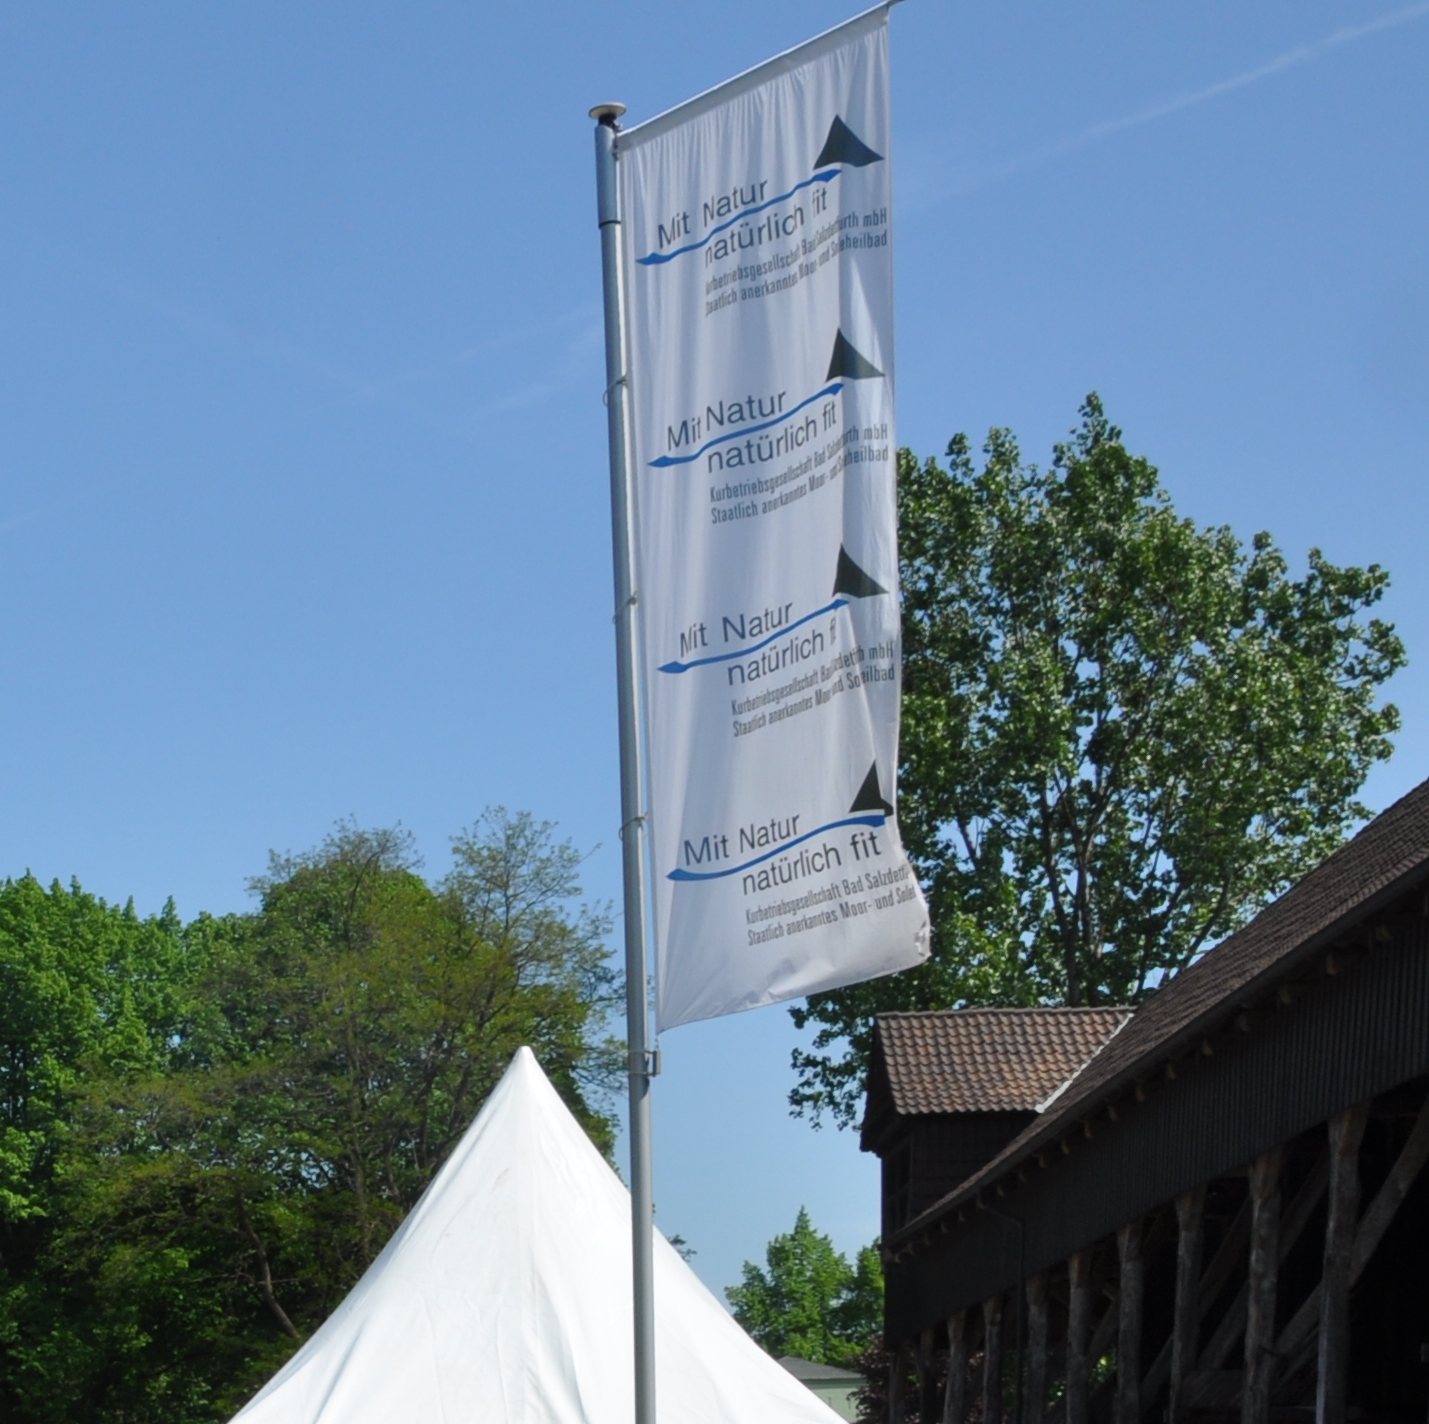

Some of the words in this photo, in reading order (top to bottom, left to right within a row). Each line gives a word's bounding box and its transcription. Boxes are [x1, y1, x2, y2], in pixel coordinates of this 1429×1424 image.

[658, 211, 690, 250] Mit
[703, 179, 768, 228] Natur
[705, 204, 805, 268] natürlich
[863, 207, 887, 227] mbH
[667, 416, 702, 451] Mit
[706, 391, 786, 432] Natur
[708, 416, 817, 473] natürlich
[823, 400, 837, 432] fit
[863, 424, 888, 440] mbH
[711, 501, 758, 524] Staatlich
[679, 622, 708, 658] Mit
[722, 602, 793, 642] Natur
[727, 629, 825, 686] natürlich
[869, 640, 894, 659] mbH
[683, 834, 730, 866] Mit
[739, 814, 800, 853] Natur
[742, 843, 841, 895] natürlich
[849, 831, 882, 862] fit
[843, 876, 863, 897] Bad
[747, 923, 784, 946] Staatlich
[785, 908, 839, 935] anerkanntes
[876, 892, 894, 911] und
